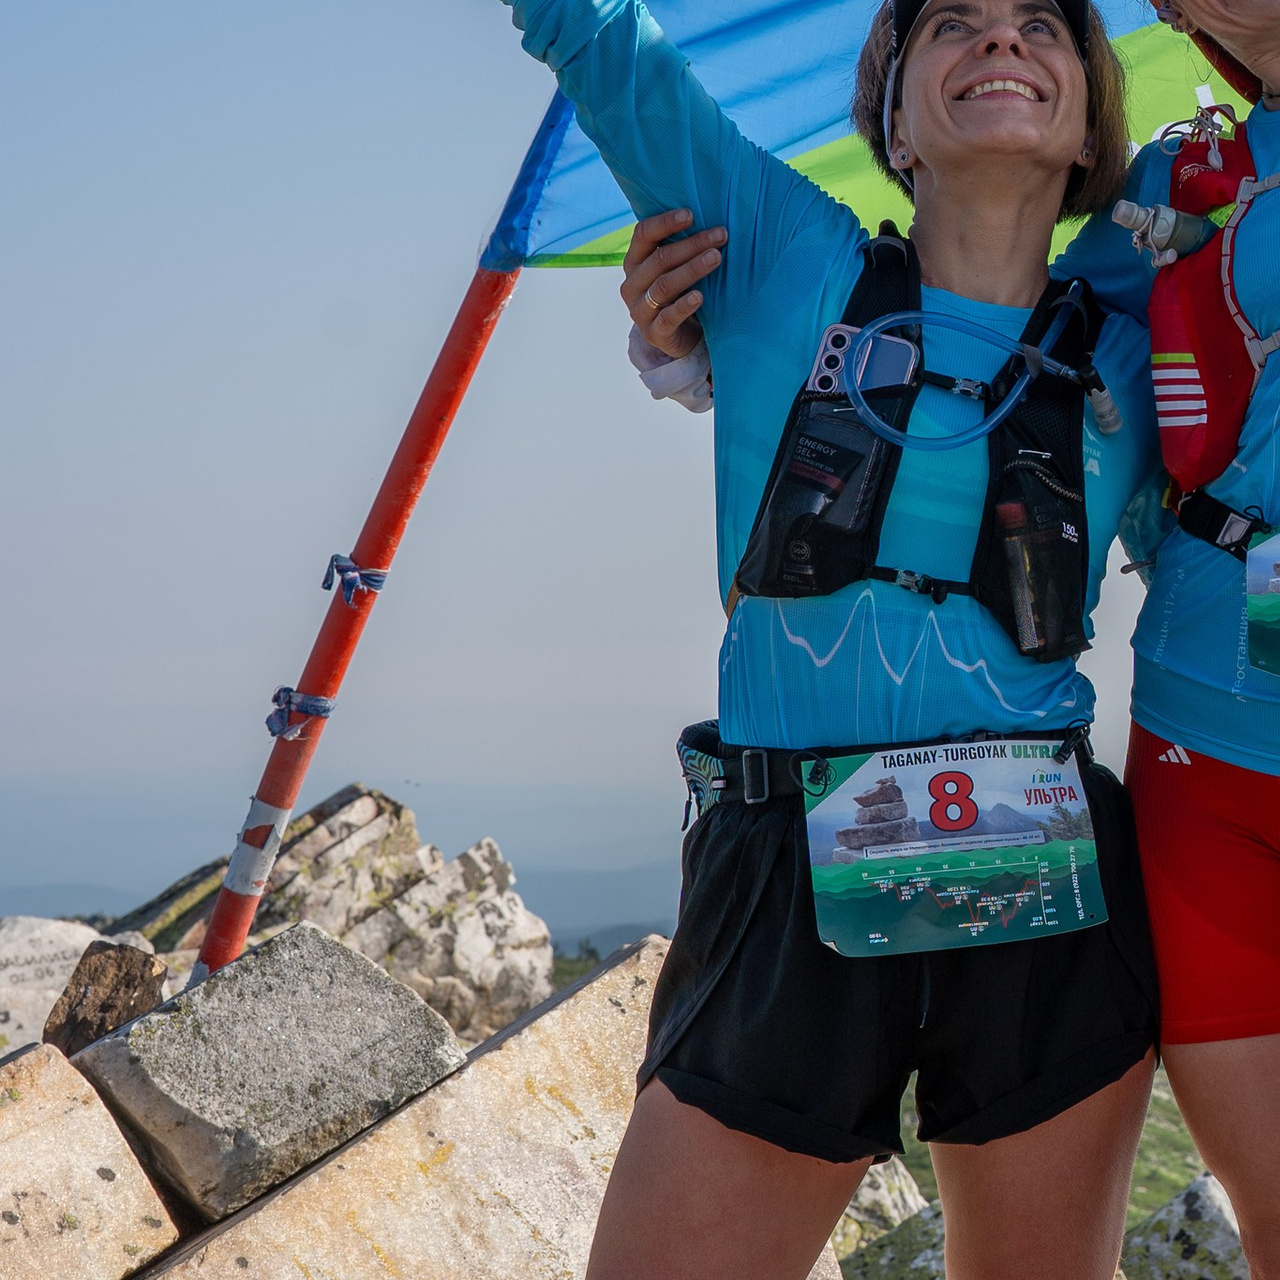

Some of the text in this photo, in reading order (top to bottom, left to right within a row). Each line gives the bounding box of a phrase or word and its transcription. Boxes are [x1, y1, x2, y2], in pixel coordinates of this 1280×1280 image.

[798, 437, 837, 456] ENERGY
[881, 745, 1007, 769] TAGANAY-TURGOYAK
[928, 771, 979, 832] 8
[1024, 786, 1078, 806] УЛЬТРА
